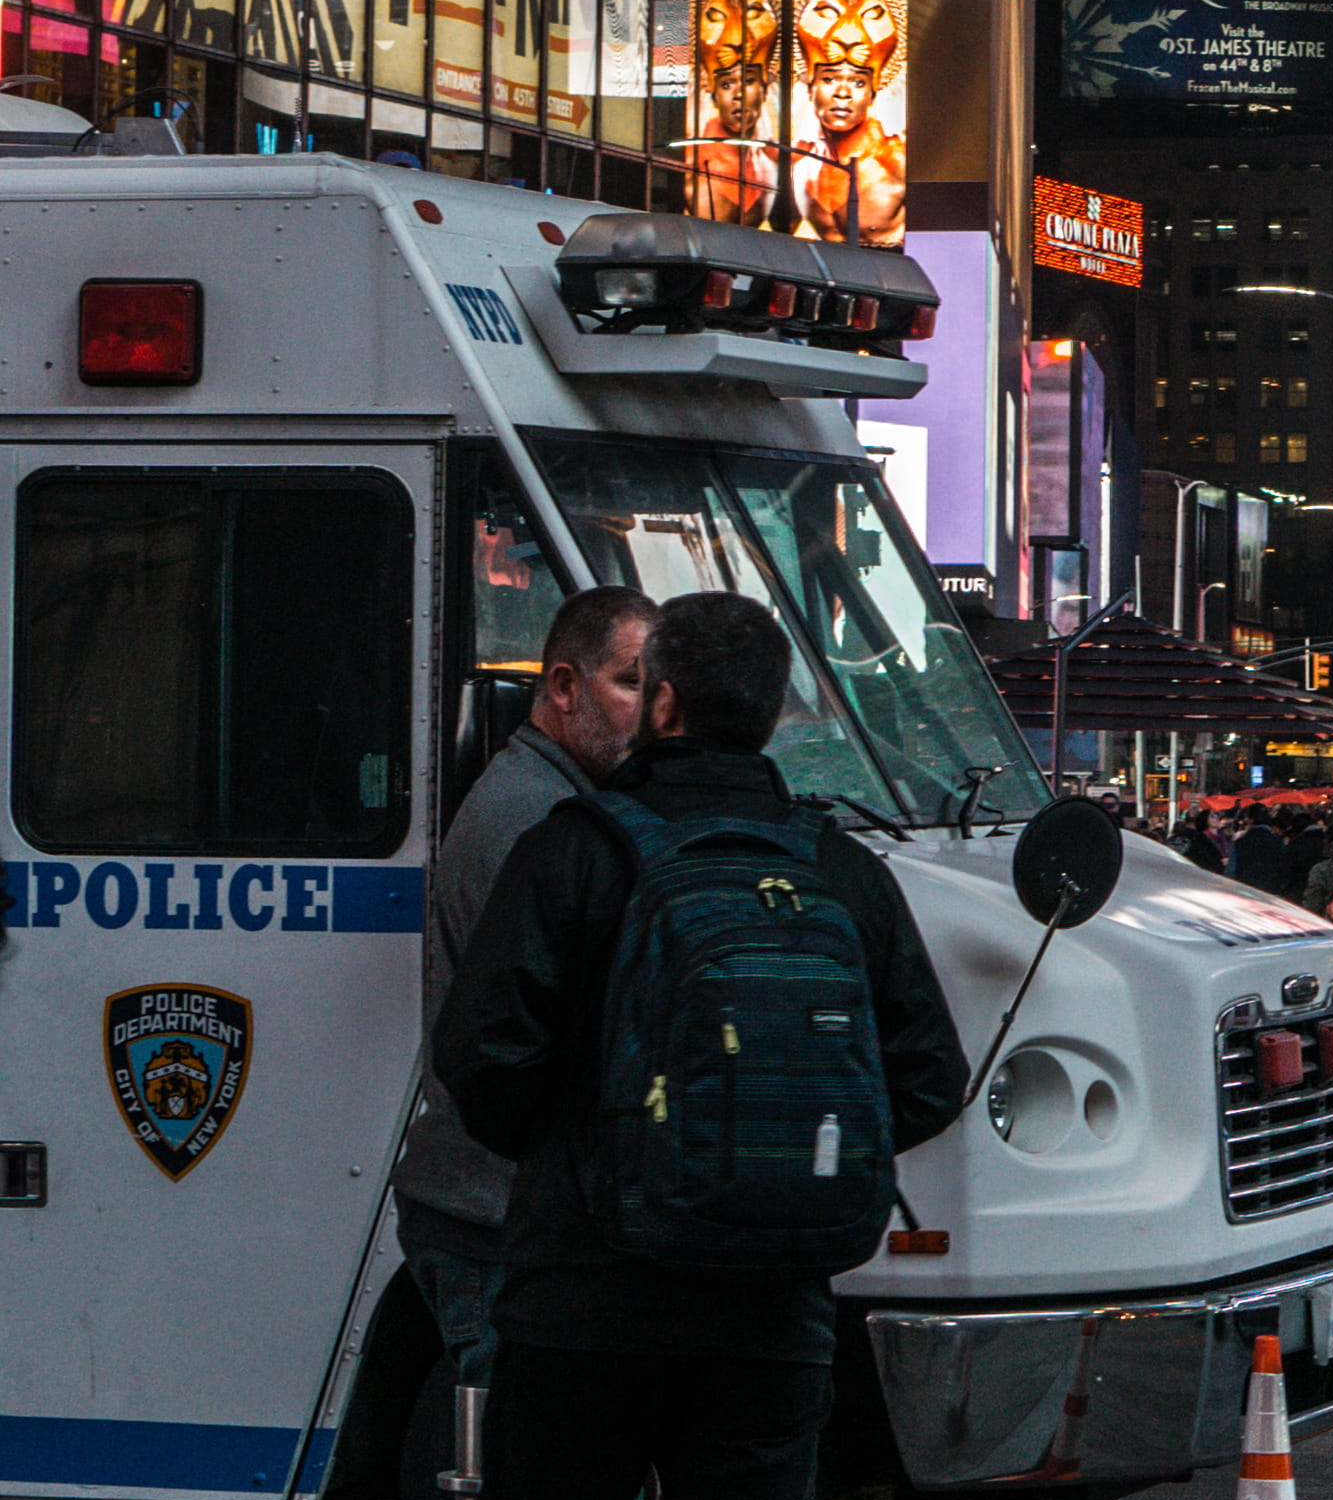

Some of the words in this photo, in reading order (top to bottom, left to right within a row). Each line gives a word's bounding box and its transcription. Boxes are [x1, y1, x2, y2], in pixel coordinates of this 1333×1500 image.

[1176, 38, 1197, 55] ST.
[1201, 38, 1251, 56] JAMES
[1256, 39, 1326, 58] THEATRE
[1221, 23, 1245, 37] Visit
[1248, 23, 1265, 38] the
[1219, 58, 1248, 72] 44TH
[1250, 59, 1260, 73] &
[1262, 58, 1283, 72] 8TH
[545, 92, 575, 120] STREET
[1045, 213, 1100, 250] CROWNE
[1102, 227, 1140, 259] PLAZA
[444, 283, 523, 345] NYPD
[32, 861, 332, 932] POLICE
[141, 993, 218, 1017] POLICE
[113, 1012, 243, 1049] DEPARTMENT
[115, 1068, 142, 1114] CITY
[136, 1121, 161, 1144] OF
[186, 1116, 219, 1156] NEW
[215, 1060, 243, 1110] YORK
